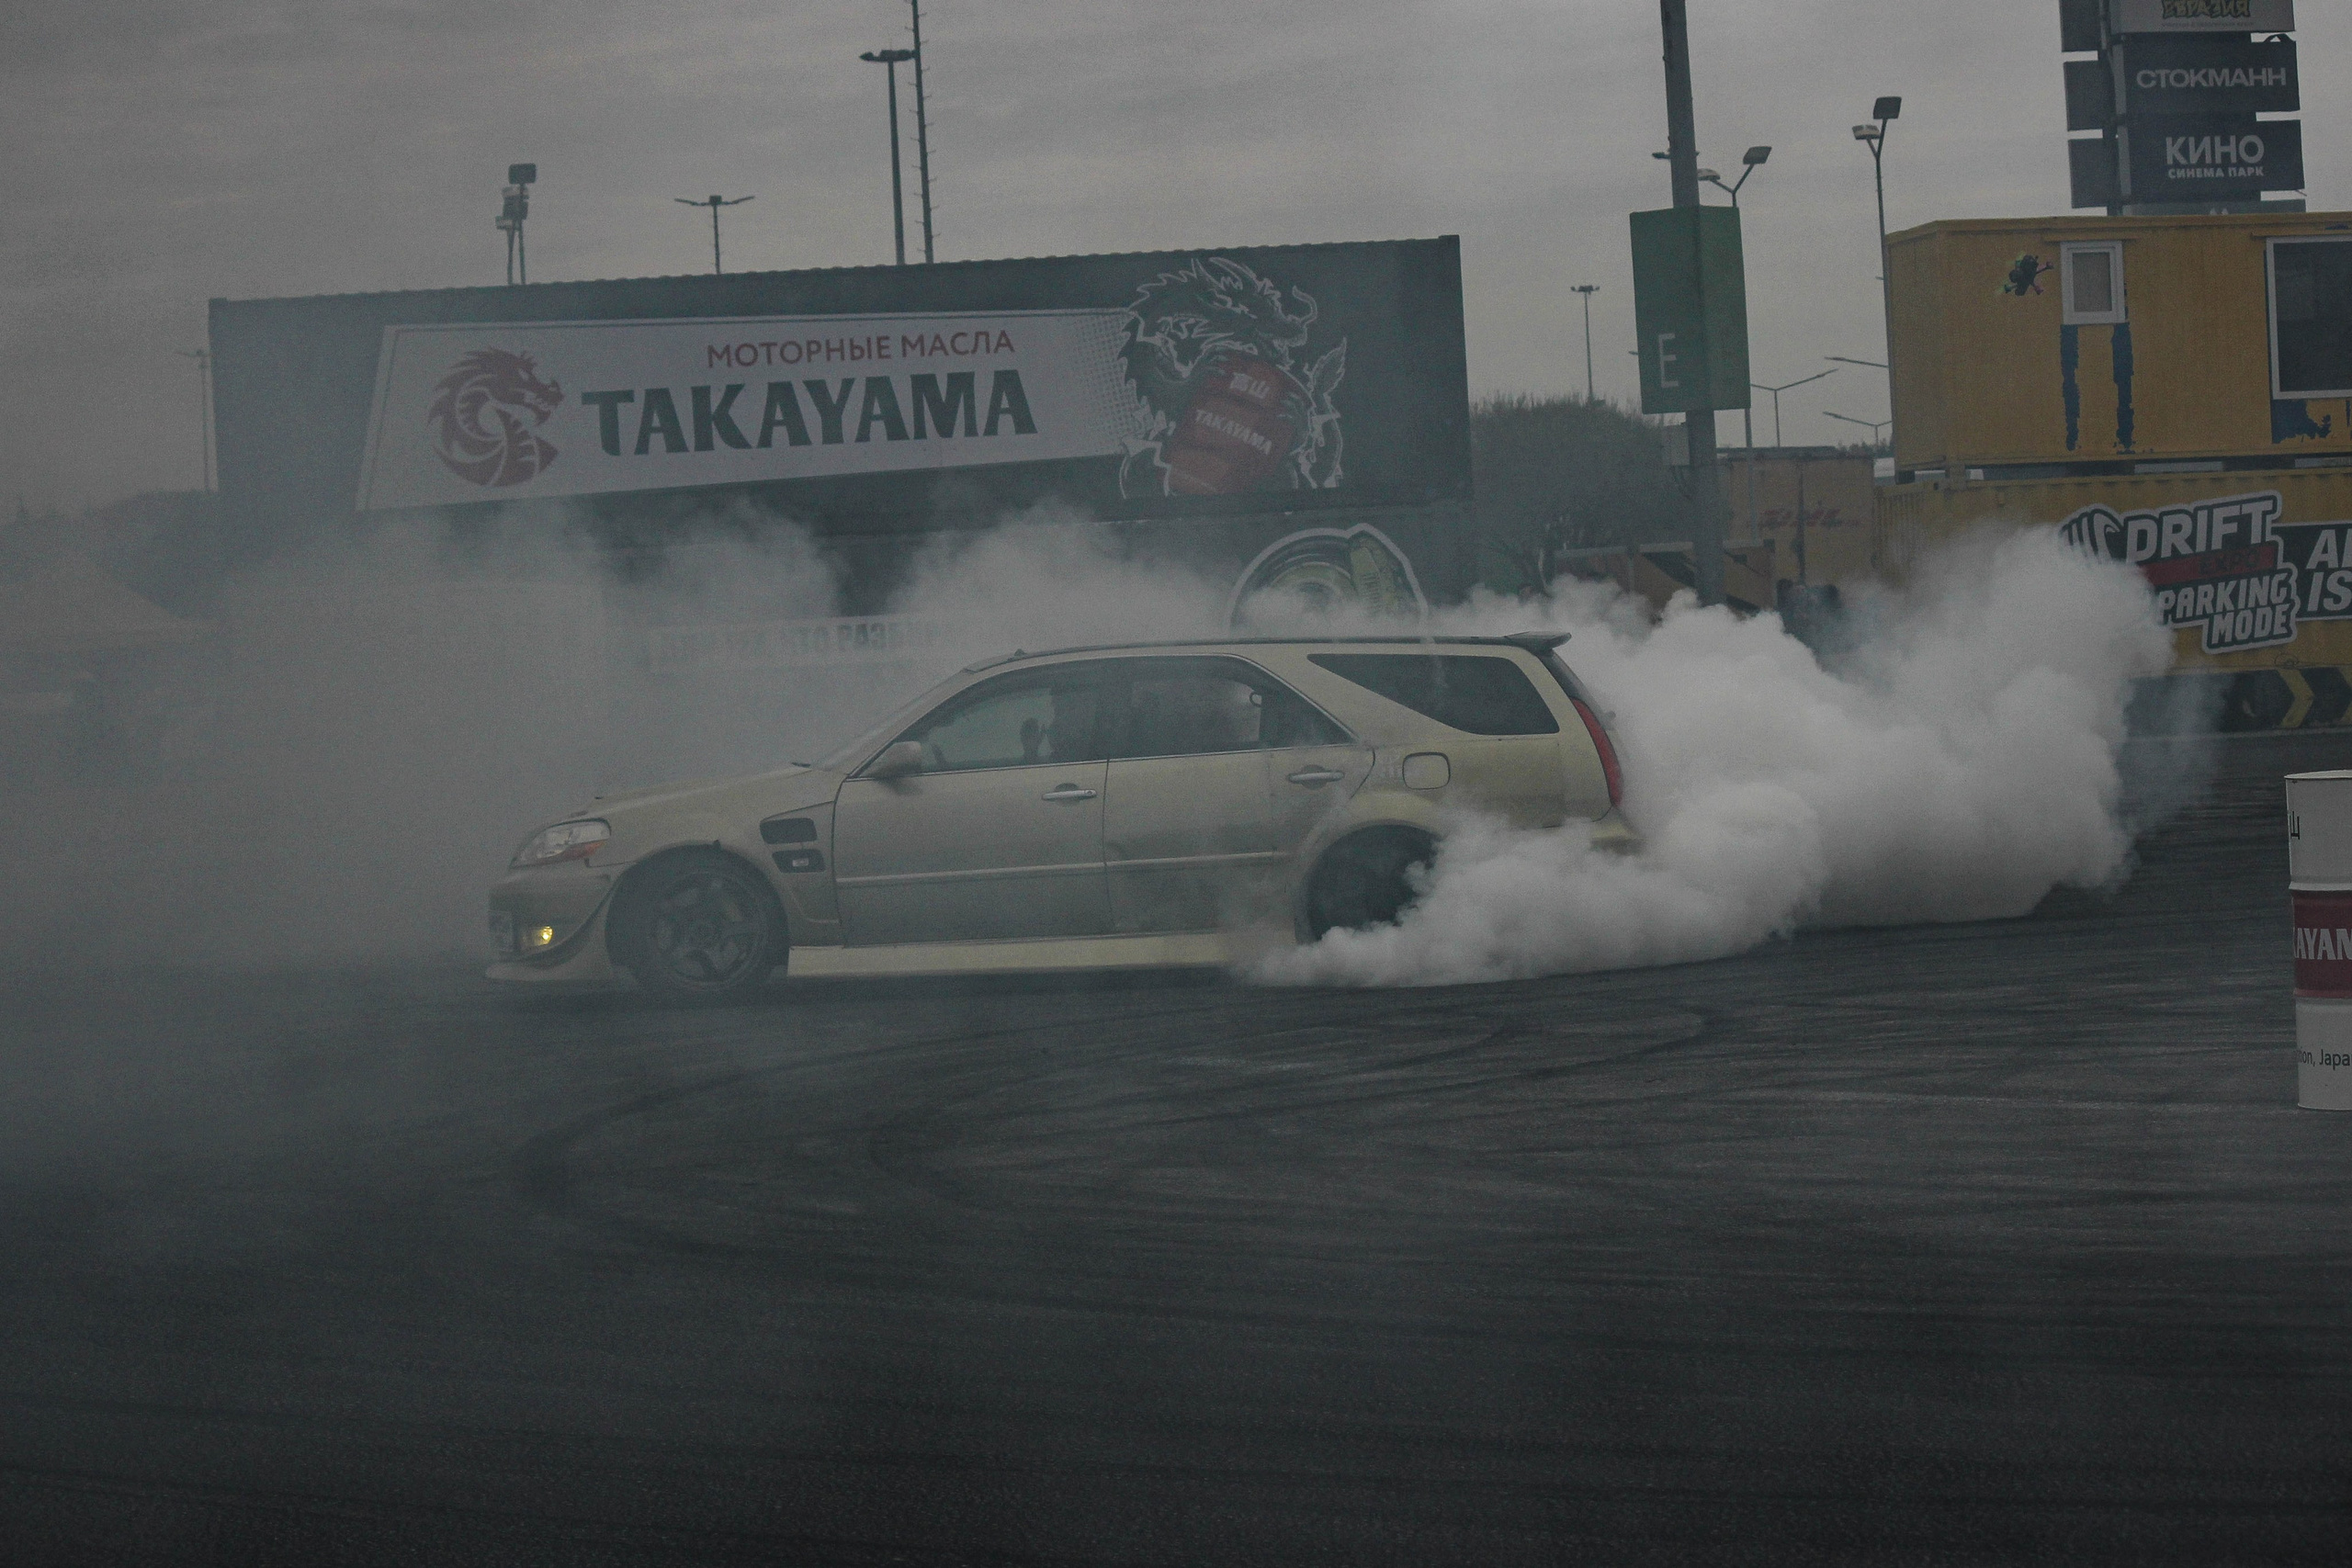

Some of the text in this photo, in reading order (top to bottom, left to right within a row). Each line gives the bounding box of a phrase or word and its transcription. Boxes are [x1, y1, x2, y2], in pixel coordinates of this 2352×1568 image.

[2136, 67, 2287, 89] СТОКМАНН
[2165, 135, 2265, 165] КИНО
[2168, 166, 2264, 179] СИНЕМА ПАРК
[707, 330, 1015, 367] МОТОРНЫЕ МАСЛА
[1658, 333, 1679, 389] E
[581, 369, 1038, 457] TAKAYAMA
[1194, 409, 1273, 456] TAKAYAMA
[2125, 500, 2274, 564] DRIFT
[2159, 570, 2291, 625] PARKING
[2211, 603, 2290, 645] MODE
[2320, 1048, 2352, 1071] Japa
